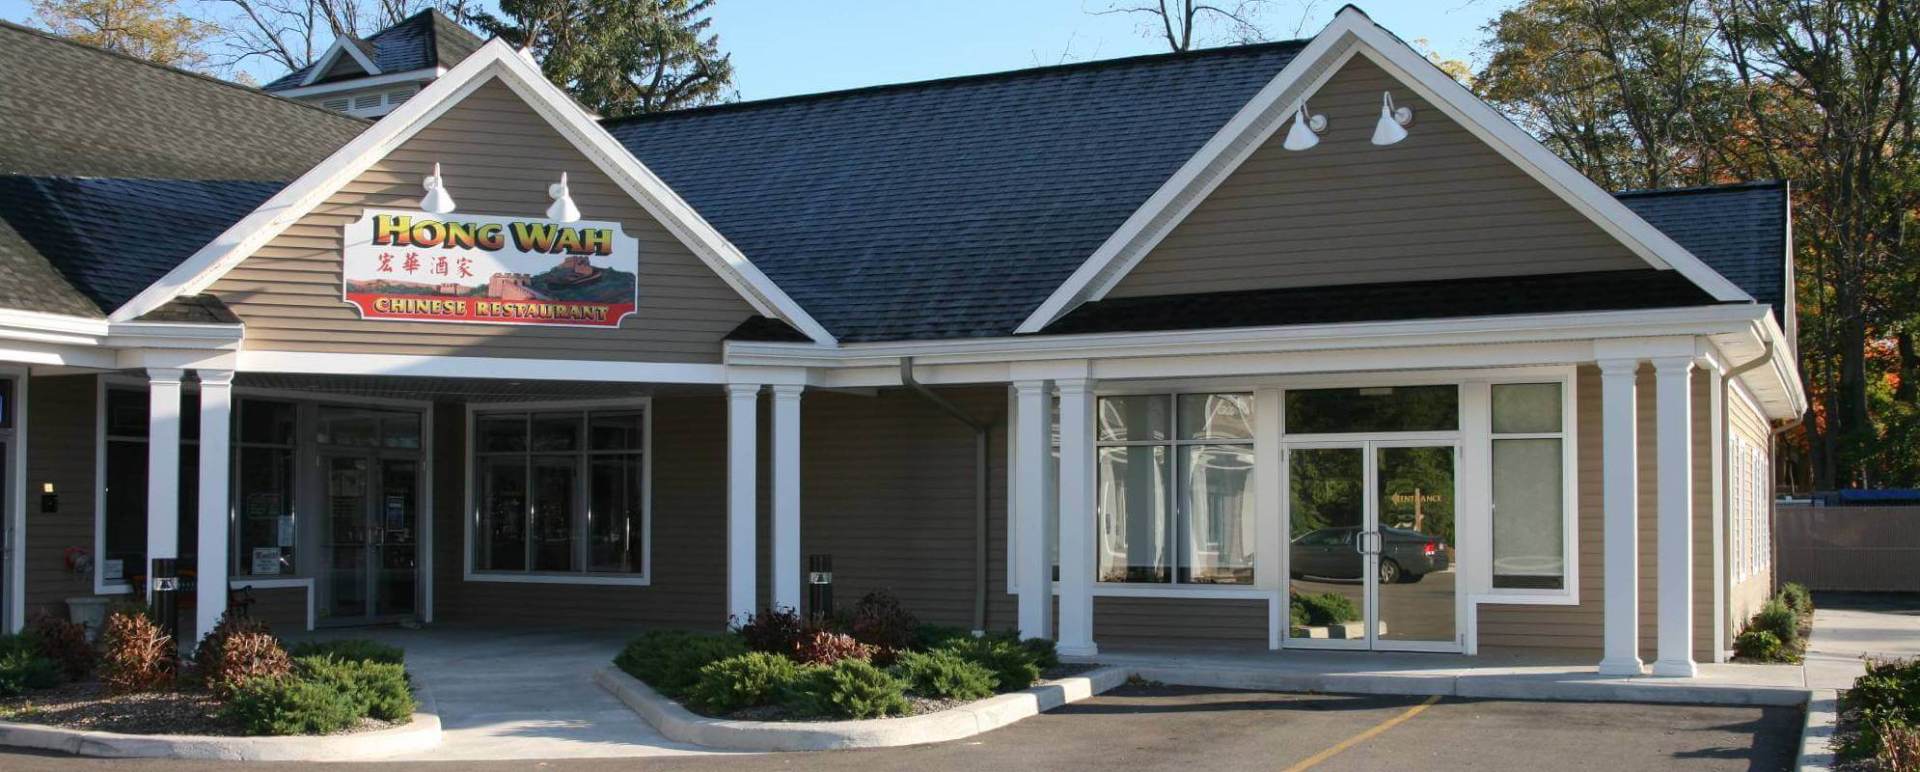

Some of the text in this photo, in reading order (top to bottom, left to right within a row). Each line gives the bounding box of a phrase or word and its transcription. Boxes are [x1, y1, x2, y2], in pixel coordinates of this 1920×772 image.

[372, 214, 613, 256] HONG WAH
[377, 252, 473, 278] 宏華酒家
[374, 298, 610, 321] CHINESE RESTAURANT
